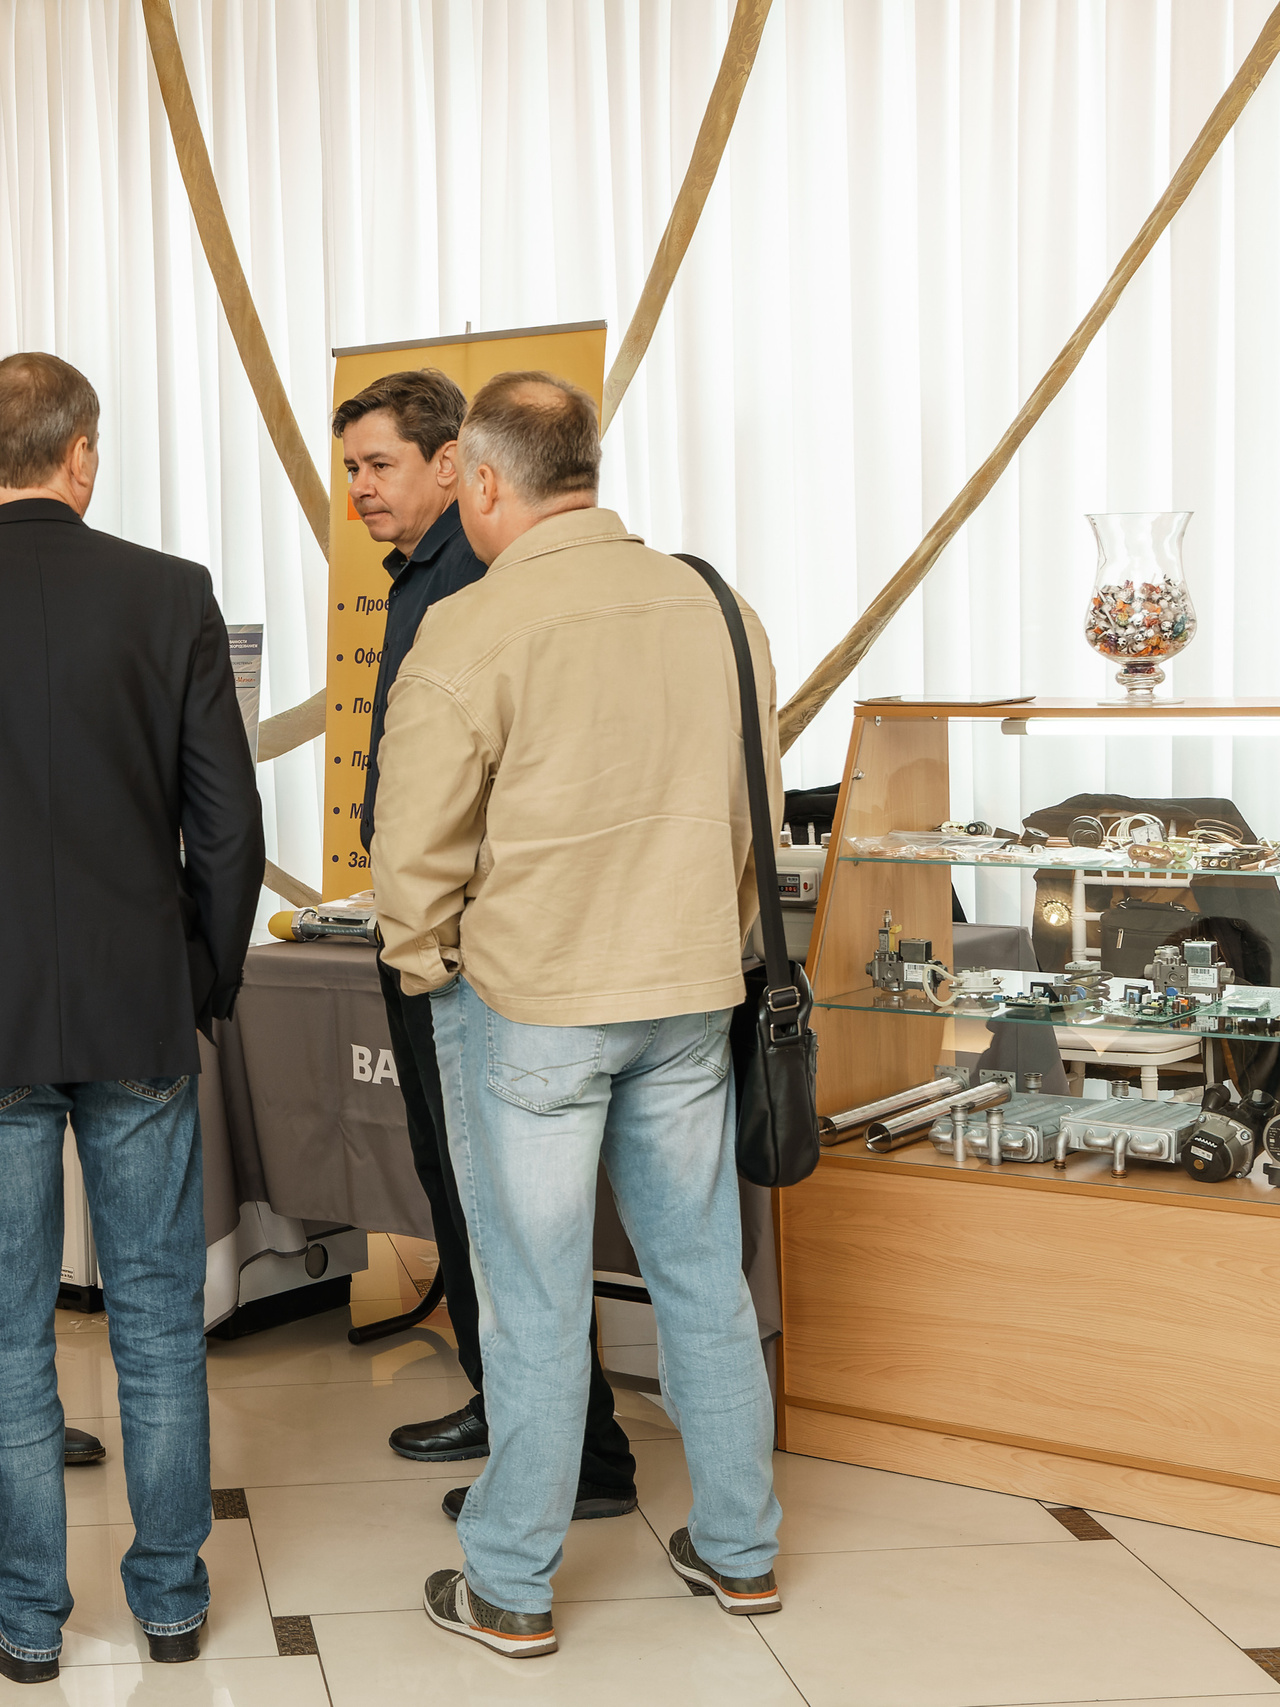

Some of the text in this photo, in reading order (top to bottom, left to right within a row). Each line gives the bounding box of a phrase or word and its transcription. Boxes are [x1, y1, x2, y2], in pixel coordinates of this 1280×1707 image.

[355, 595, 390, 616] Прое
[352, 697, 373, 714] По
[351, 750, 370, 771] Пр
[348, 851, 371, 869] За
[350, 1043, 400, 1087] BA
